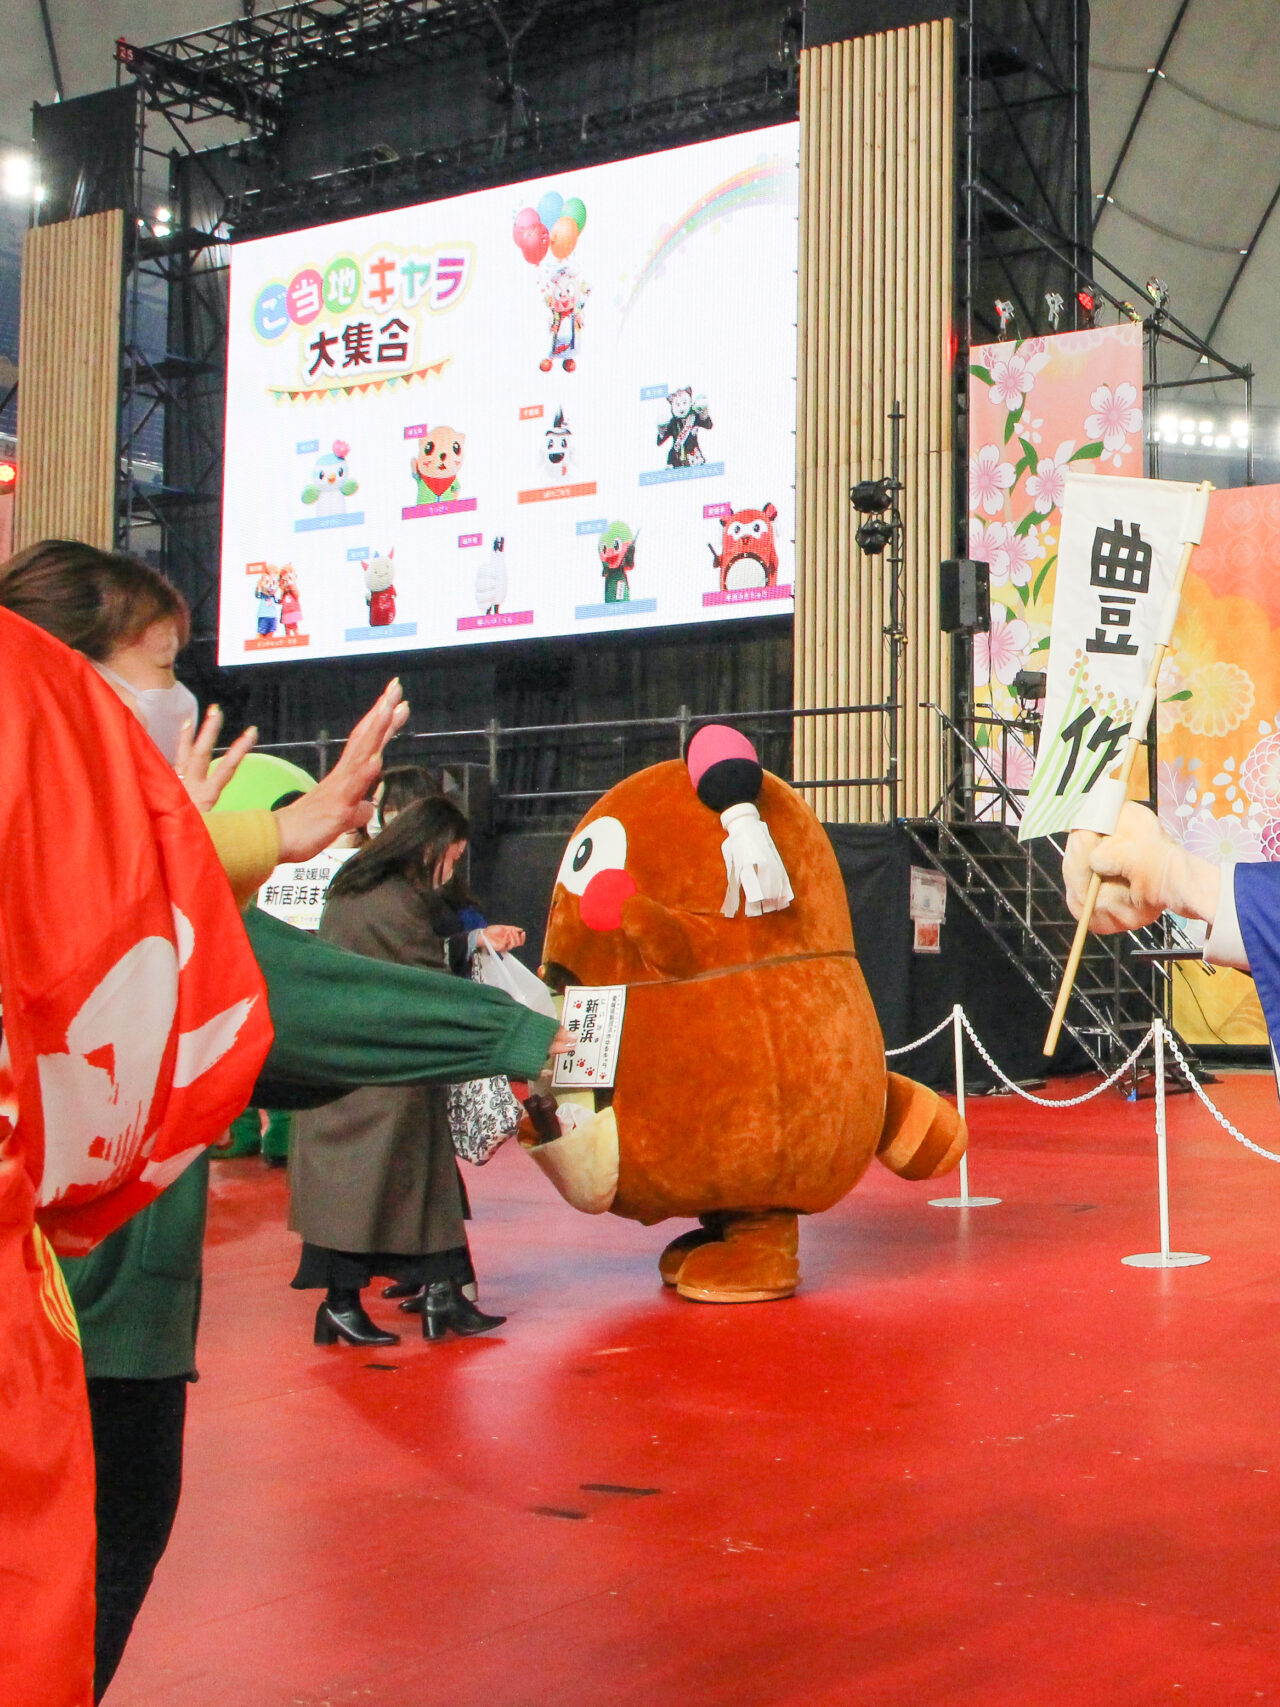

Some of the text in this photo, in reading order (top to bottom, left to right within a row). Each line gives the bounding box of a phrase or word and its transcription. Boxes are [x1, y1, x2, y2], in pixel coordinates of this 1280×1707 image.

[262, 257, 464, 330] ご当地キャラ
[309, 318, 409, 376] 大集合
[293, 868, 330, 880] 愛媛県
[563, 1019, 580, 1073] まゅり
[580, 999, 599, 1043] 新居浜
